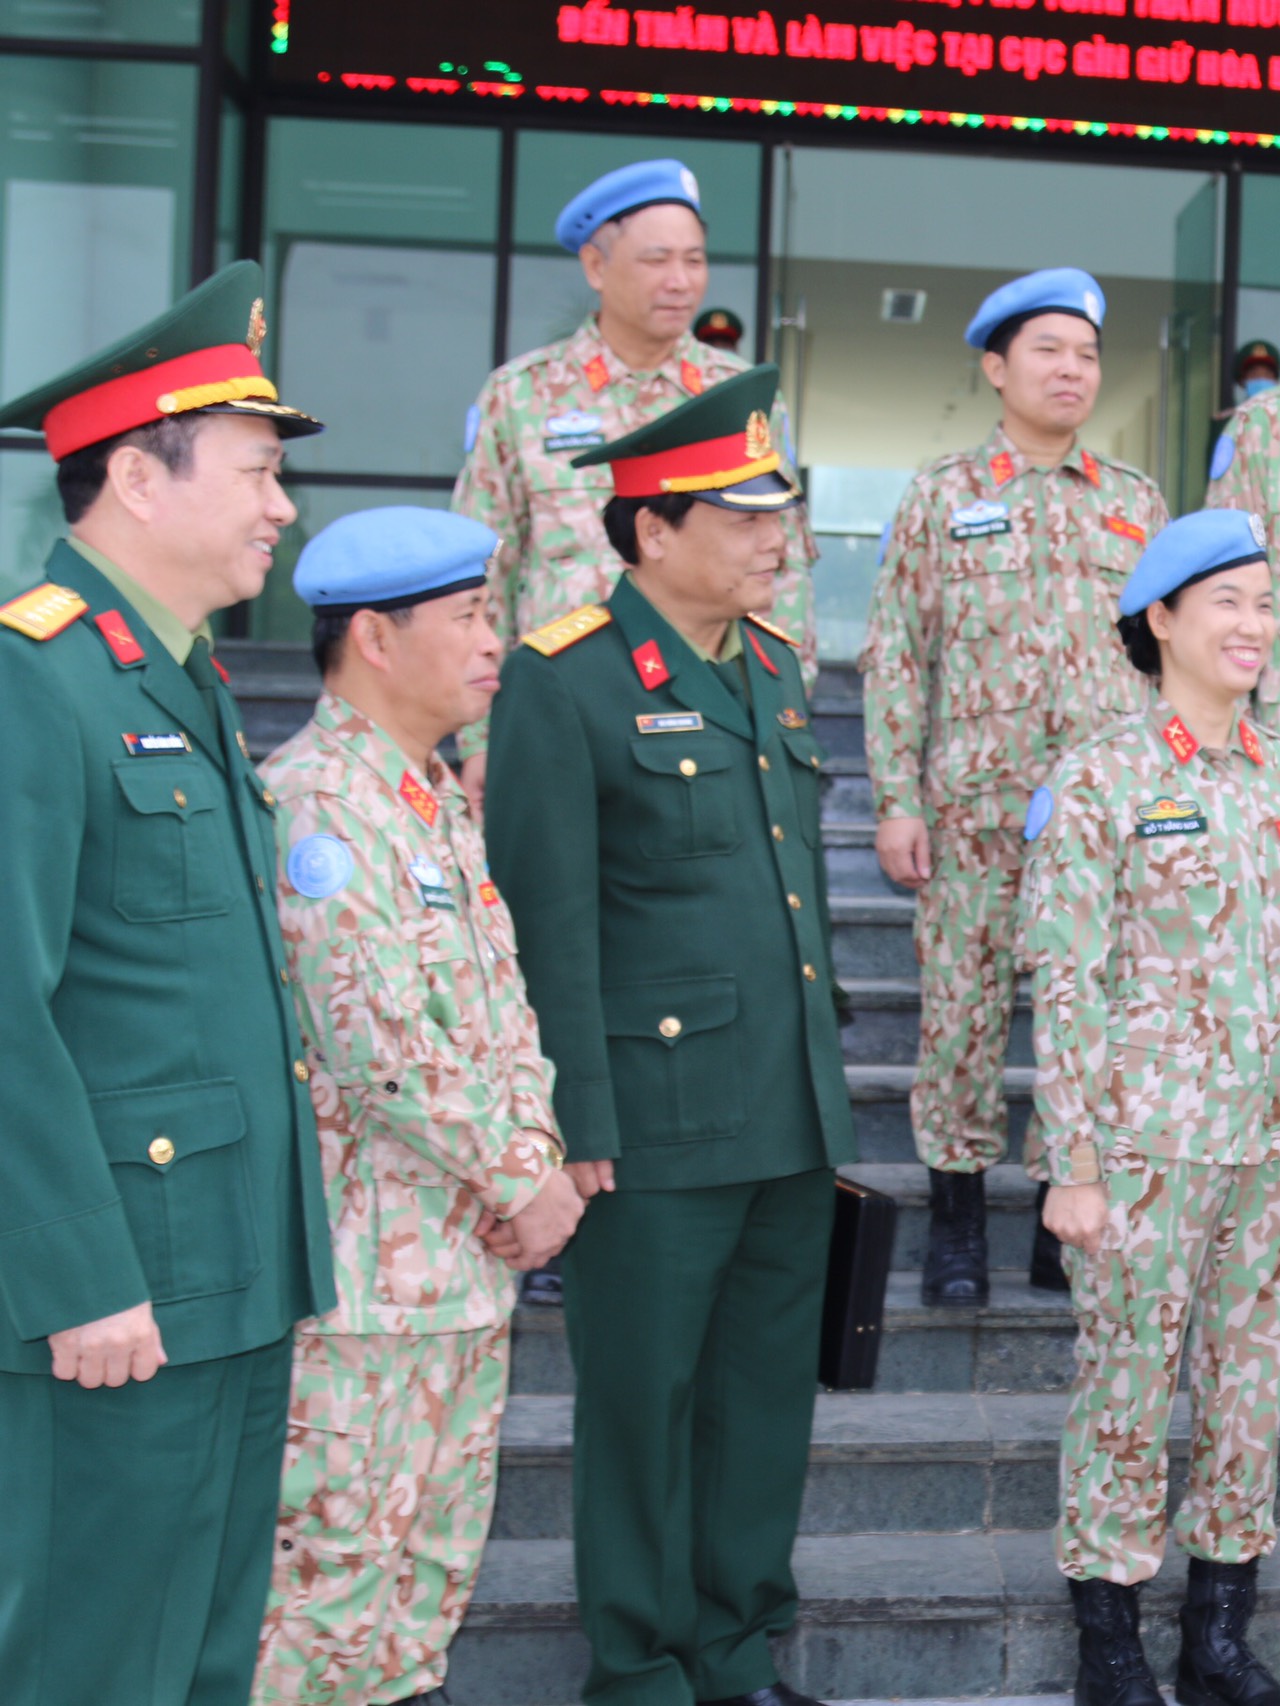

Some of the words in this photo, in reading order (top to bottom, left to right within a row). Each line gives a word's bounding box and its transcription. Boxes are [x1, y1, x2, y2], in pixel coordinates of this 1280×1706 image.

[730, 10, 780, 56] VÀ
[785, 13, 858, 61] LÀM
[858, 20, 938, 72] VIỆC
[941, 31, 994, 77] TẠI
[999, 35, 1068, 81] CỤC
